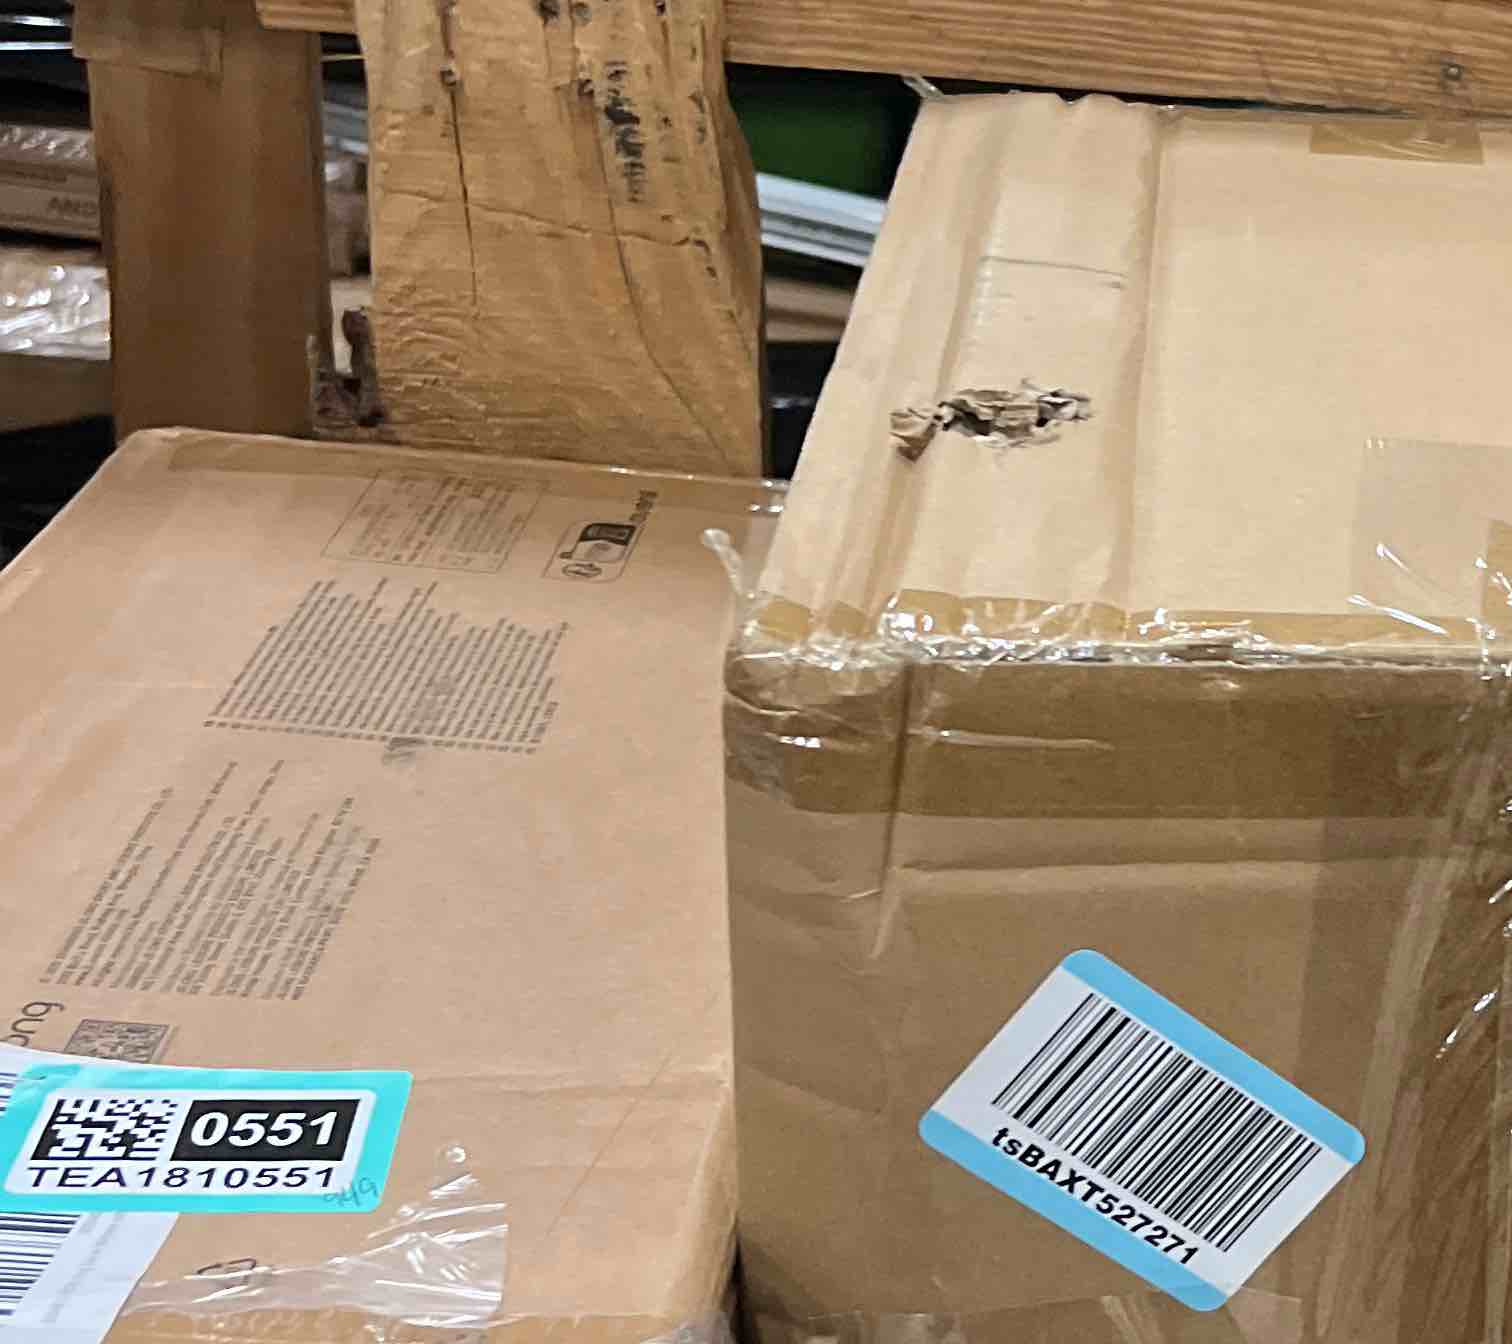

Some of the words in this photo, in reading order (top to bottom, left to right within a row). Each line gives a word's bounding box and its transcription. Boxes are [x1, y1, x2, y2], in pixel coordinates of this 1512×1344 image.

[189, 1108, 339, 1149] 0551
[28, 1165, 336, 1191] TEA1810551
[990, 1127, 1198, 1267] tsBAXT527271
